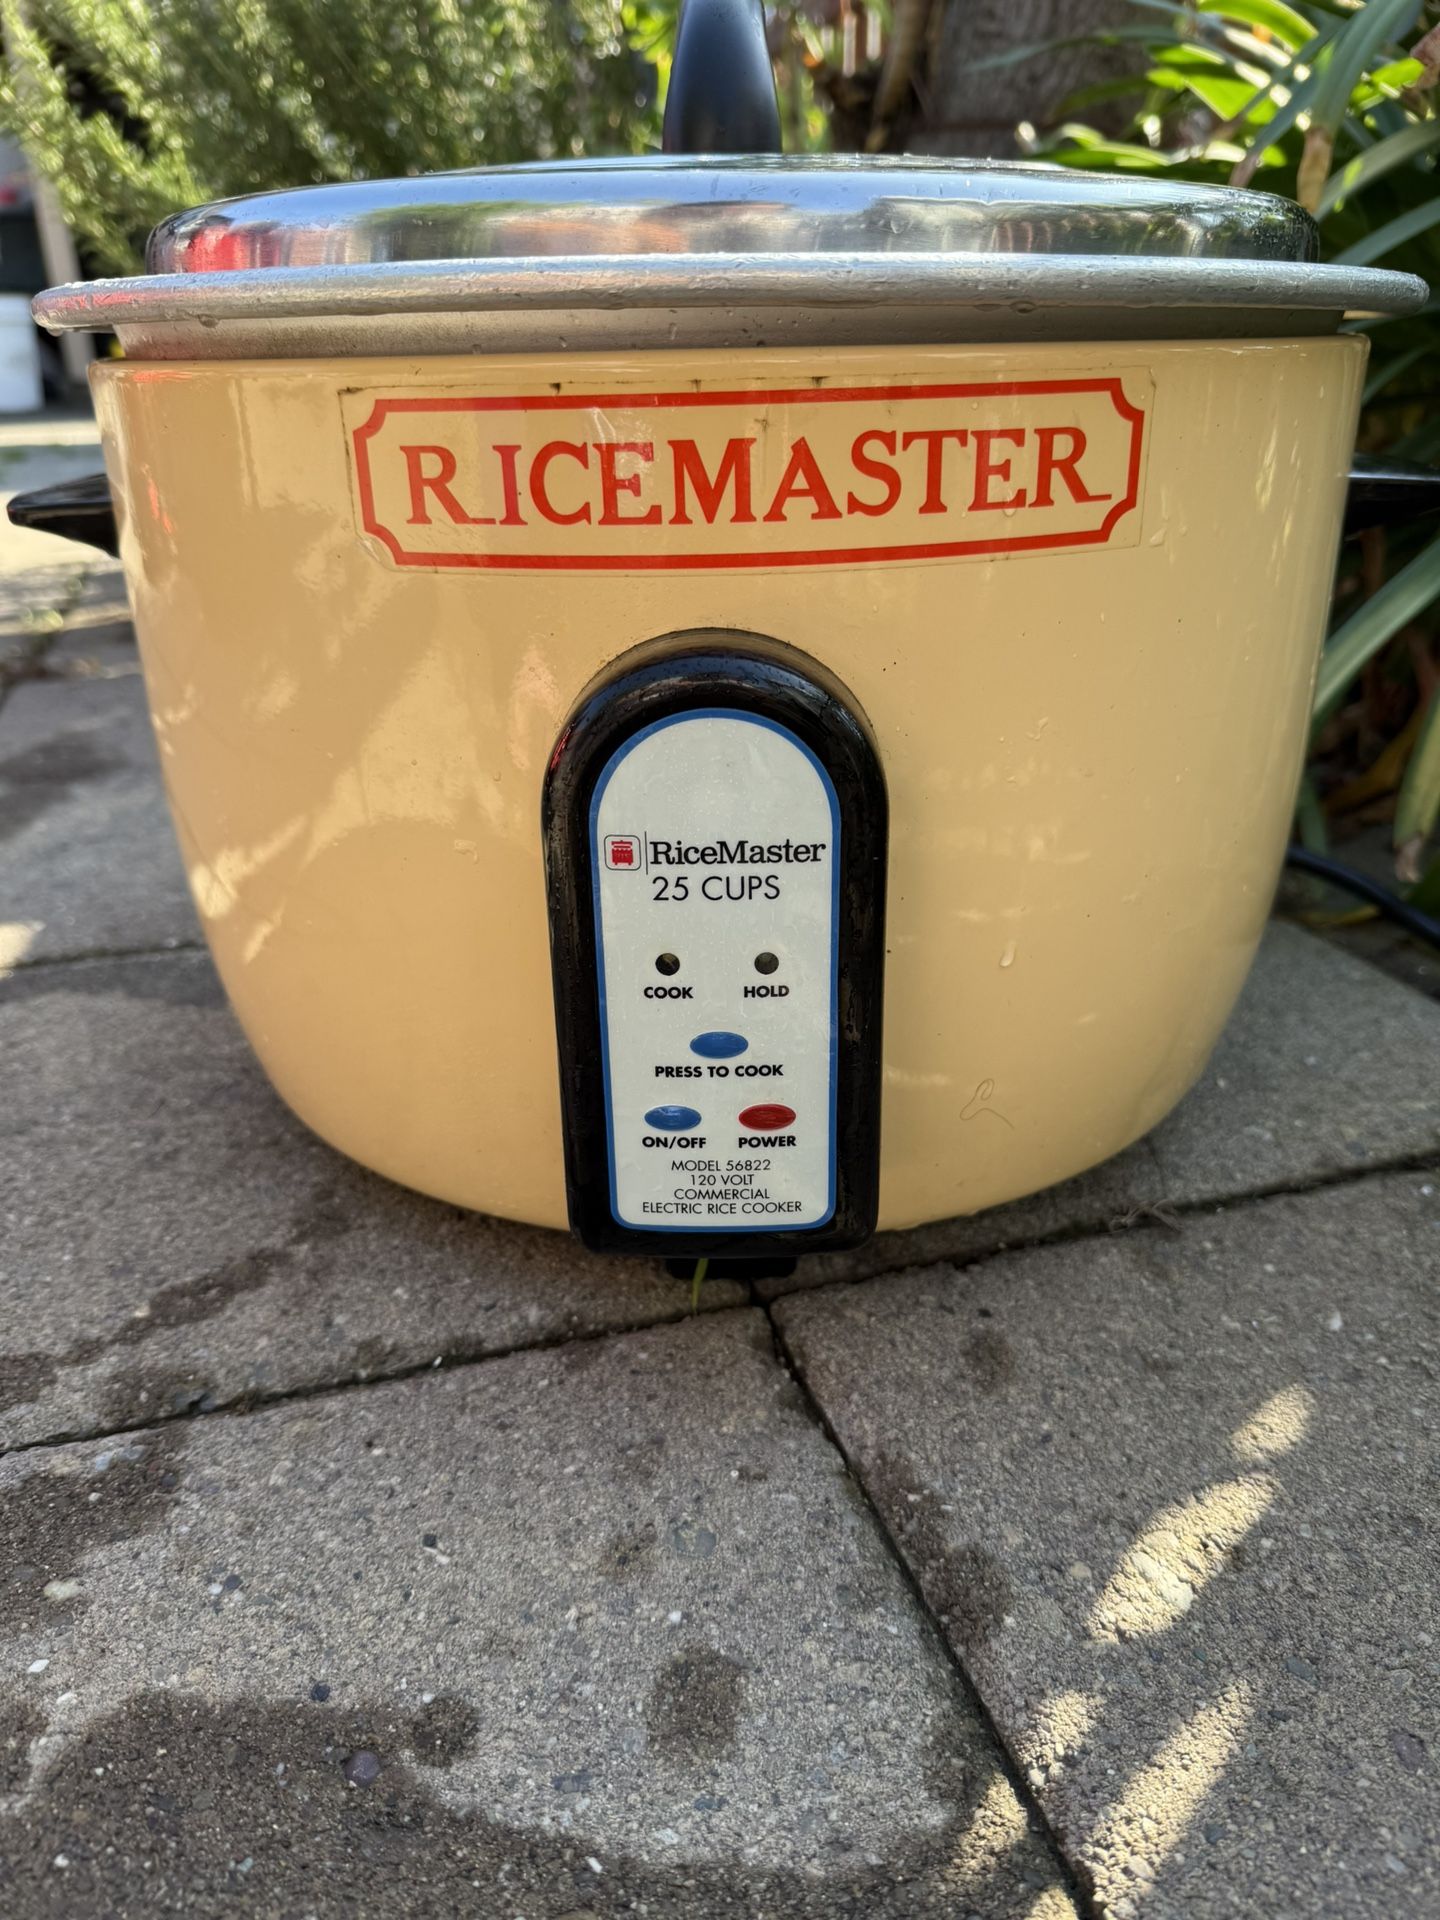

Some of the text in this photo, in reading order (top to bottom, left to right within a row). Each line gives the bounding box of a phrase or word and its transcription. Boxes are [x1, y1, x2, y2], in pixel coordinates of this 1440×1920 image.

[398, 426, 1113, 527] RICEMASTER
[649, 838, 827, 866] RiceMaster
[652, 874, 781, 901] 25 CUPS
[643, 986, 694, 999] COOK
[743, 985, 790, 998] HOLD
[655, 1064, 784, 1078] PRESS TO COOK
[642, 1136, 707, 1149] ON/OFF
[738, 1135, 797, 1148] POWER
[671, 1159, 771, 1172] MODEL 56822
[690, 1174, 755, 1186] 120 VOLT
[673, 1188, 770, 1200] COMMERCIAL
[642, 1201, 802, 1214] ELECTRIC RICE COOKER
